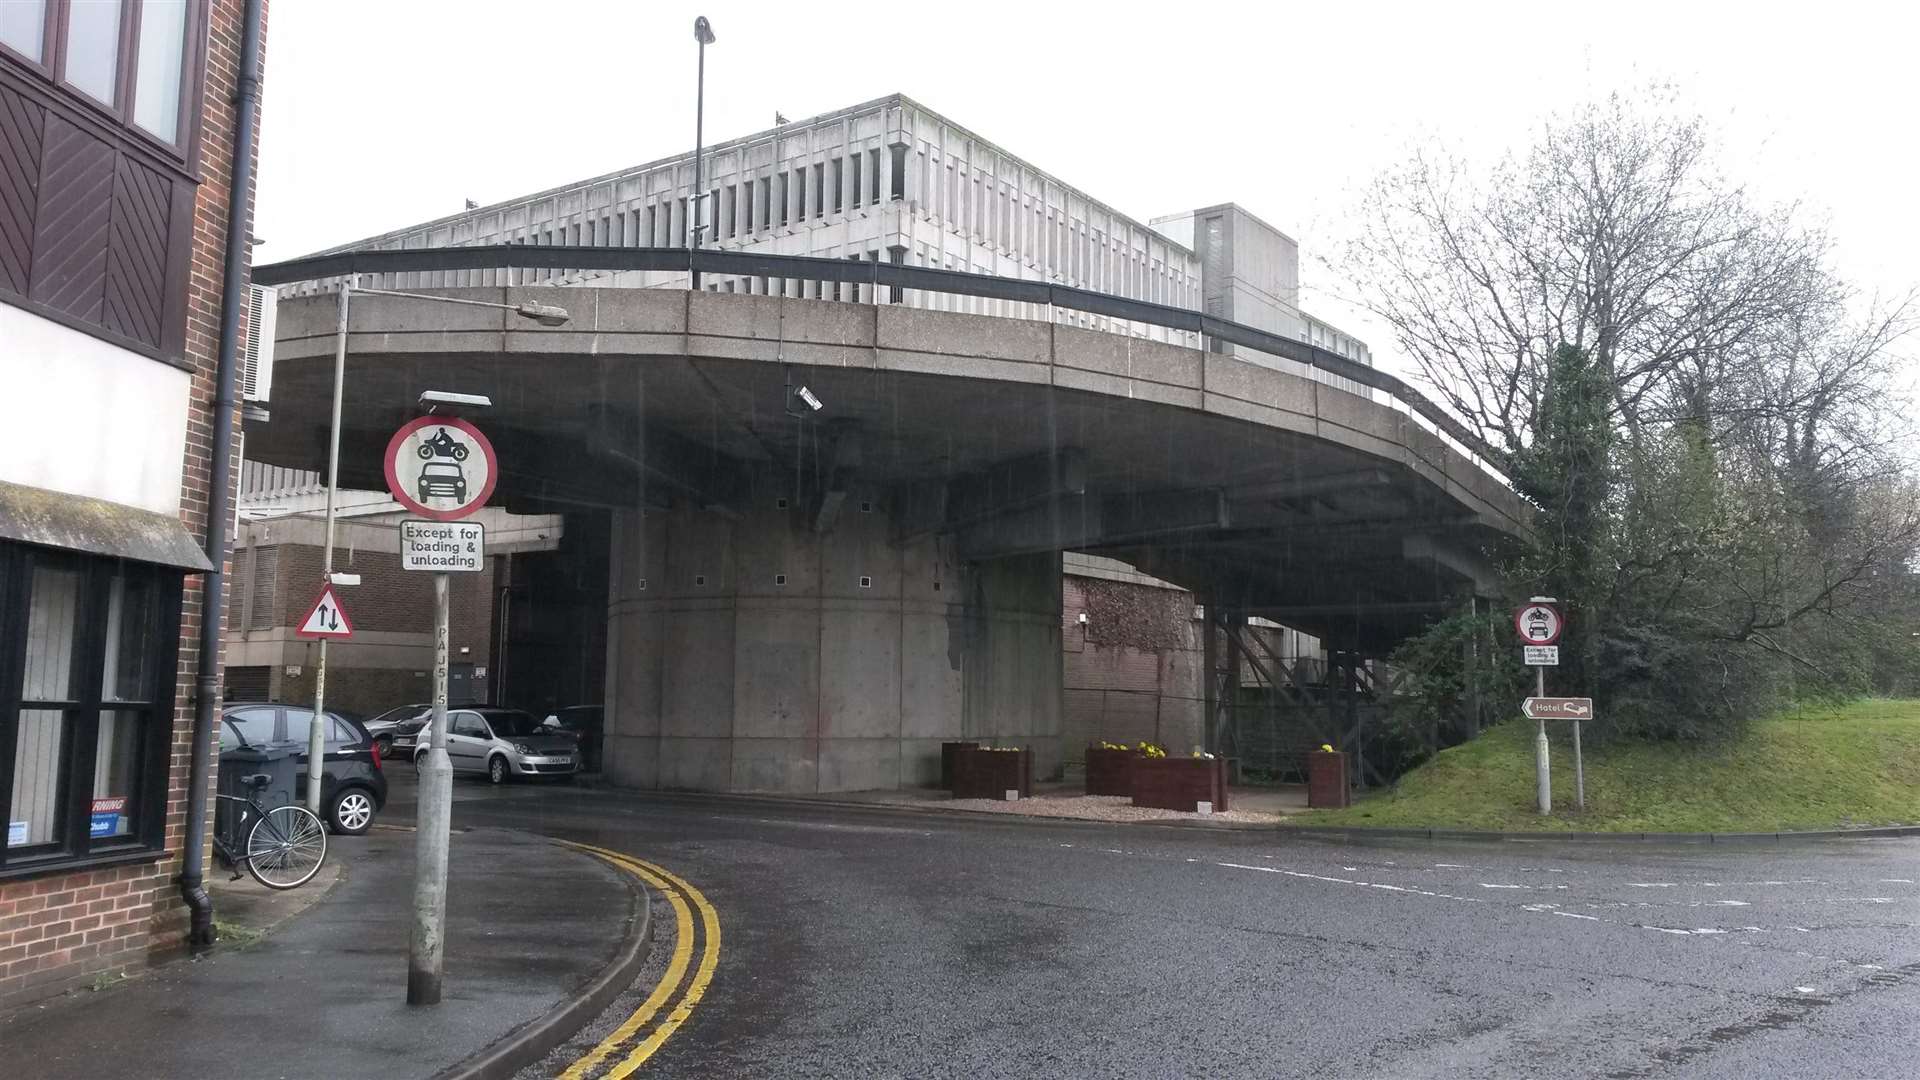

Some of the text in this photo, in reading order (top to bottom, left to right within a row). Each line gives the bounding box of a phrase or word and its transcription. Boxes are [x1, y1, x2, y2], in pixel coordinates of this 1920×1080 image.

[406, 526, 478, 540] Except for
[411, 540, 476, 554] loading &
[411, 555, 475, 568] unloading
[92, 800, 124, 811] RNING
